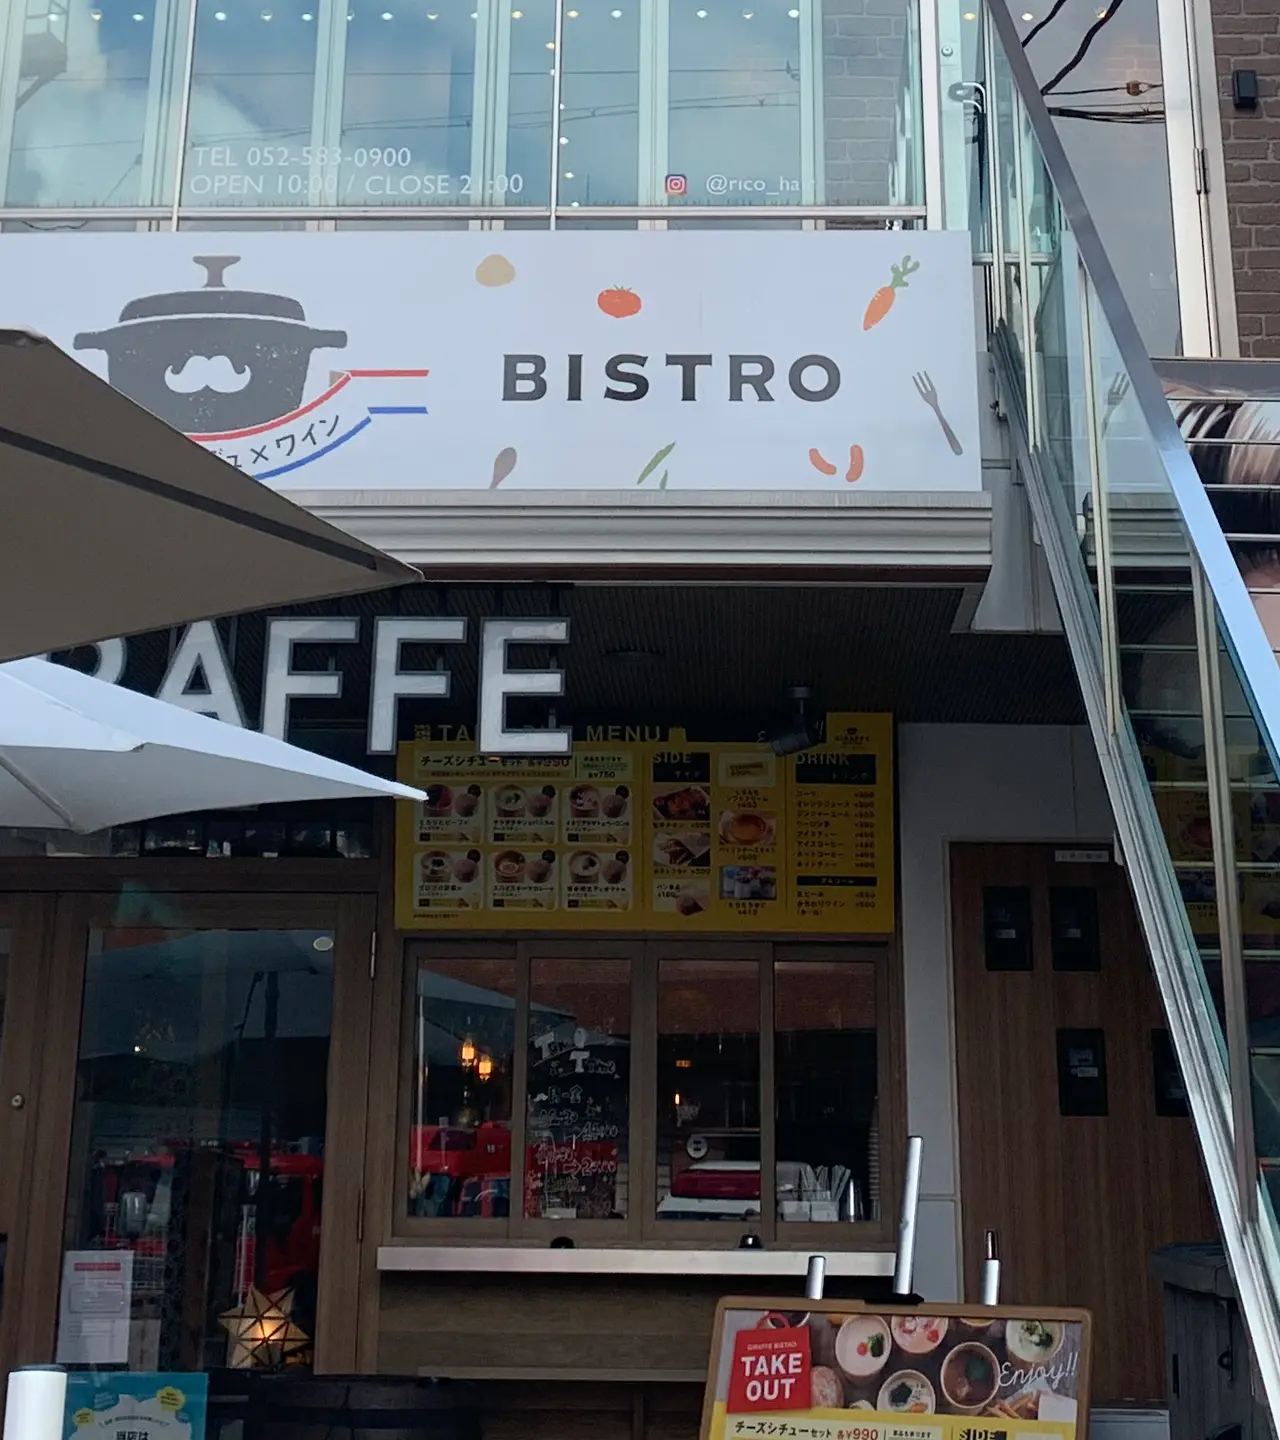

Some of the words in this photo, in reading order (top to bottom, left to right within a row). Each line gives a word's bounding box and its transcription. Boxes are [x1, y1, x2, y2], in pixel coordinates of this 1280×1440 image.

[195, 146, 238, 167] TEL
[246, 146, 412, 167] 052-583-0900
[190, 174, 263, 195] OPEN
[278, 173, 337, 195] 10:00
[366, 174, 451, 195] CLOSE
[501, 353, 841, 402] BISTRO
[586, 725, 661, 742] MENU
[653, 751, 693, 764] SIDE
[741, 1353, 803, 1377] TAKE
[998, 1351, 1079, 1394] Enjoy!!
[746, 1378, 796, 1402] OUT
